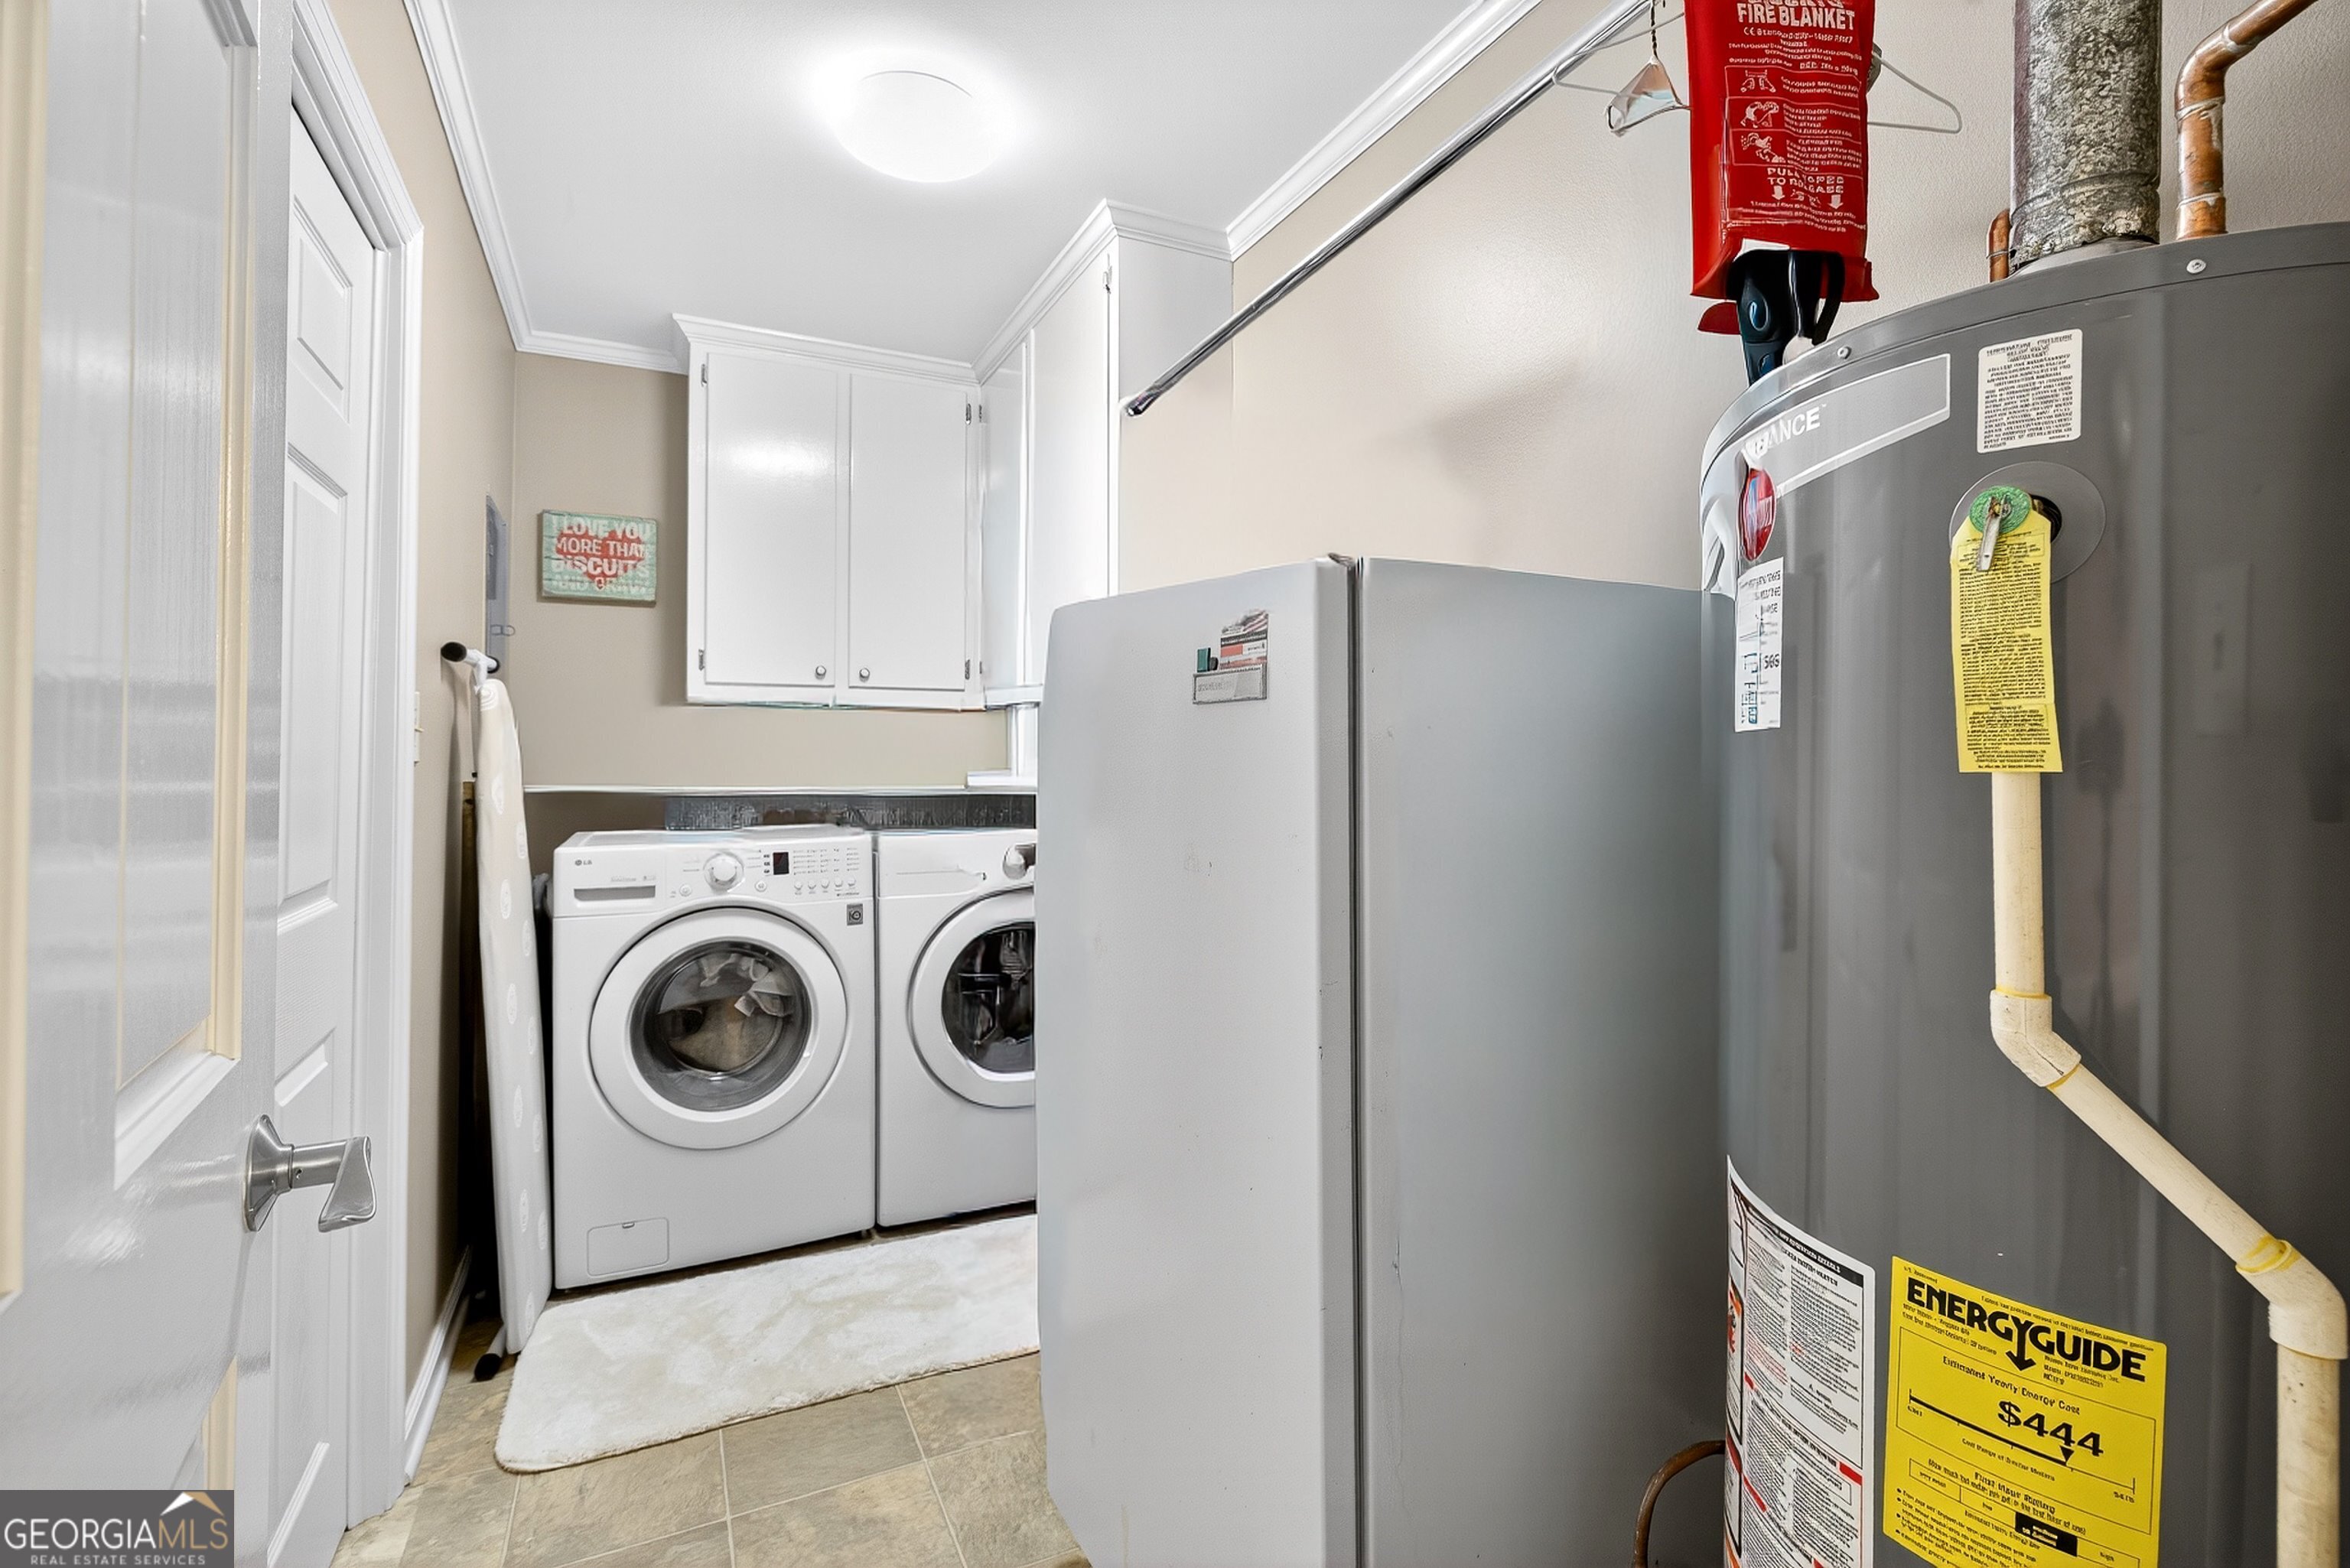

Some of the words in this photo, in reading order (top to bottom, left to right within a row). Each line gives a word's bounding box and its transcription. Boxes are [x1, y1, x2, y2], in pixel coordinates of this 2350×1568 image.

[1736, 3, 1776, 24] FIRE
[1779, 6, 1855, 30] BLANKET
[1767, 177, 1786, 186] TO
[614, 521, 652, 540] YOU
[556, 537, 603, 555] MORE
[1907, 1277, 2147, 1382] ENERGYGUIDE
[1997, 1400, 2104, 1457] $444
